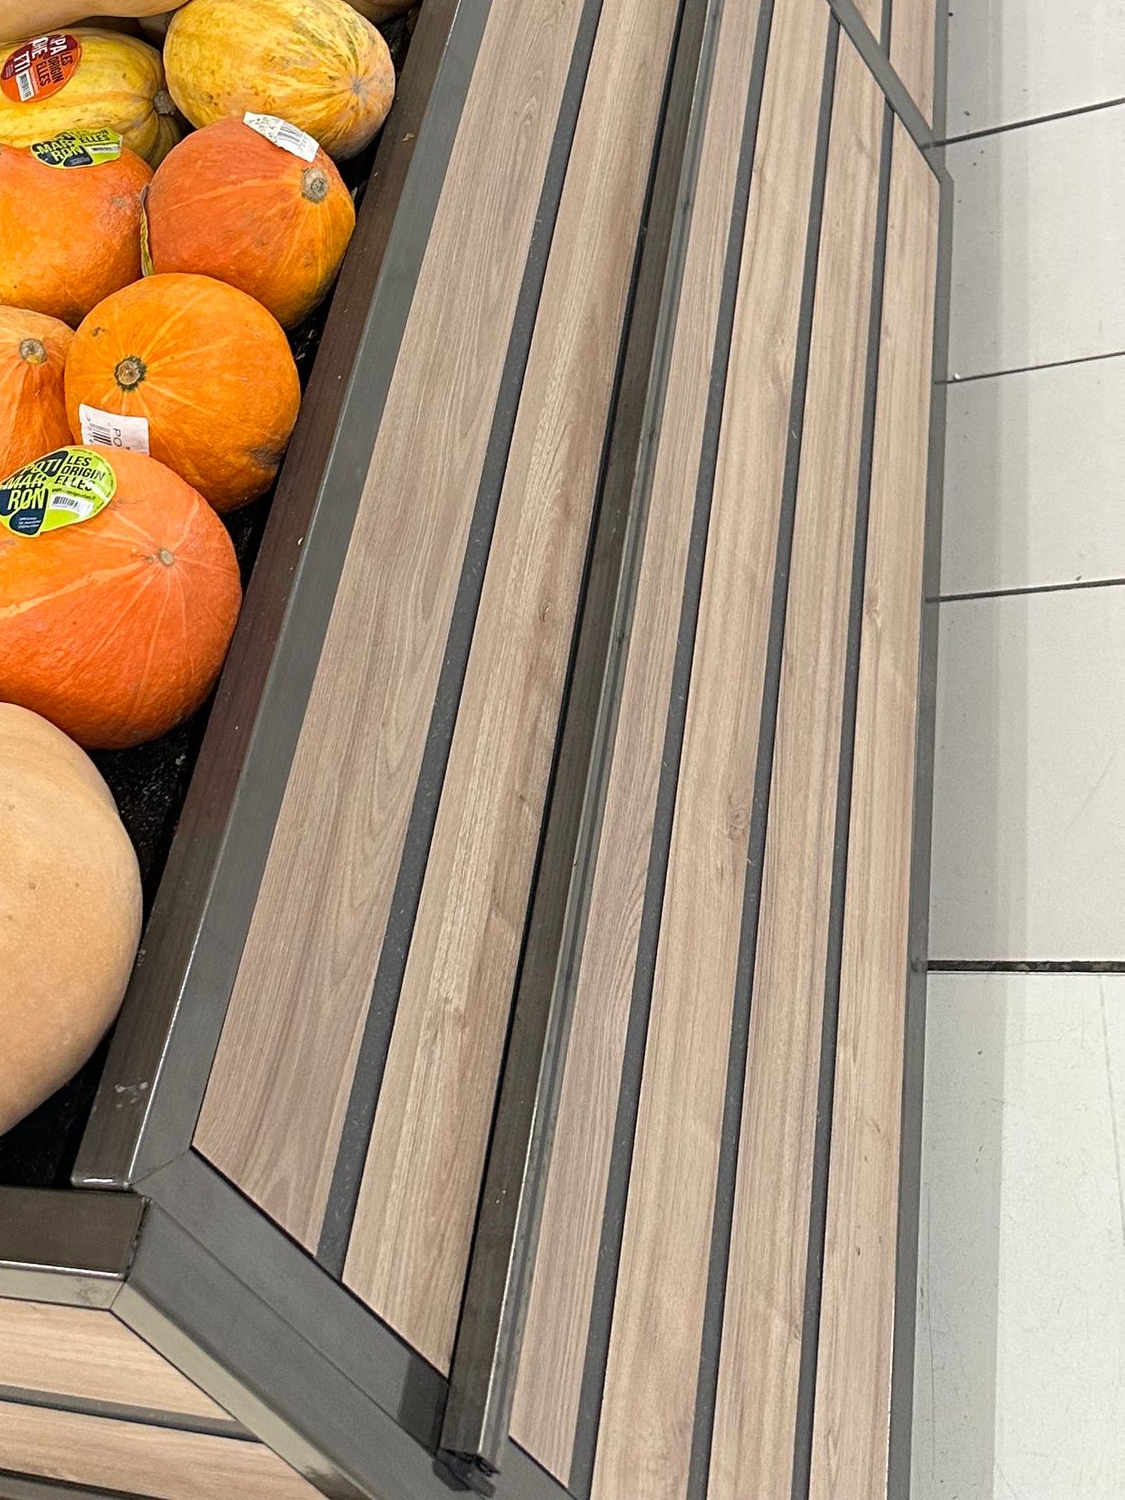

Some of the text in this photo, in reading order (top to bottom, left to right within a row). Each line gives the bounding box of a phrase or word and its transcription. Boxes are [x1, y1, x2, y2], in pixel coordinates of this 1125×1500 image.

[14, 50, 31, 76] TTI
[60, 52, 74, 67] LES
[36, 59, 51, 88] ELLES
[48, 56, 64, 84] ORIGIN
[50, 145, 84, 162] RON
[22, 458, 63, 473] POTI
[67, 455, 92, 467] LES
[60, 465, 106, 481] ORIGIN
[54, 475, 96, 492] ELLES
[7, 488, 46, 511] RON
